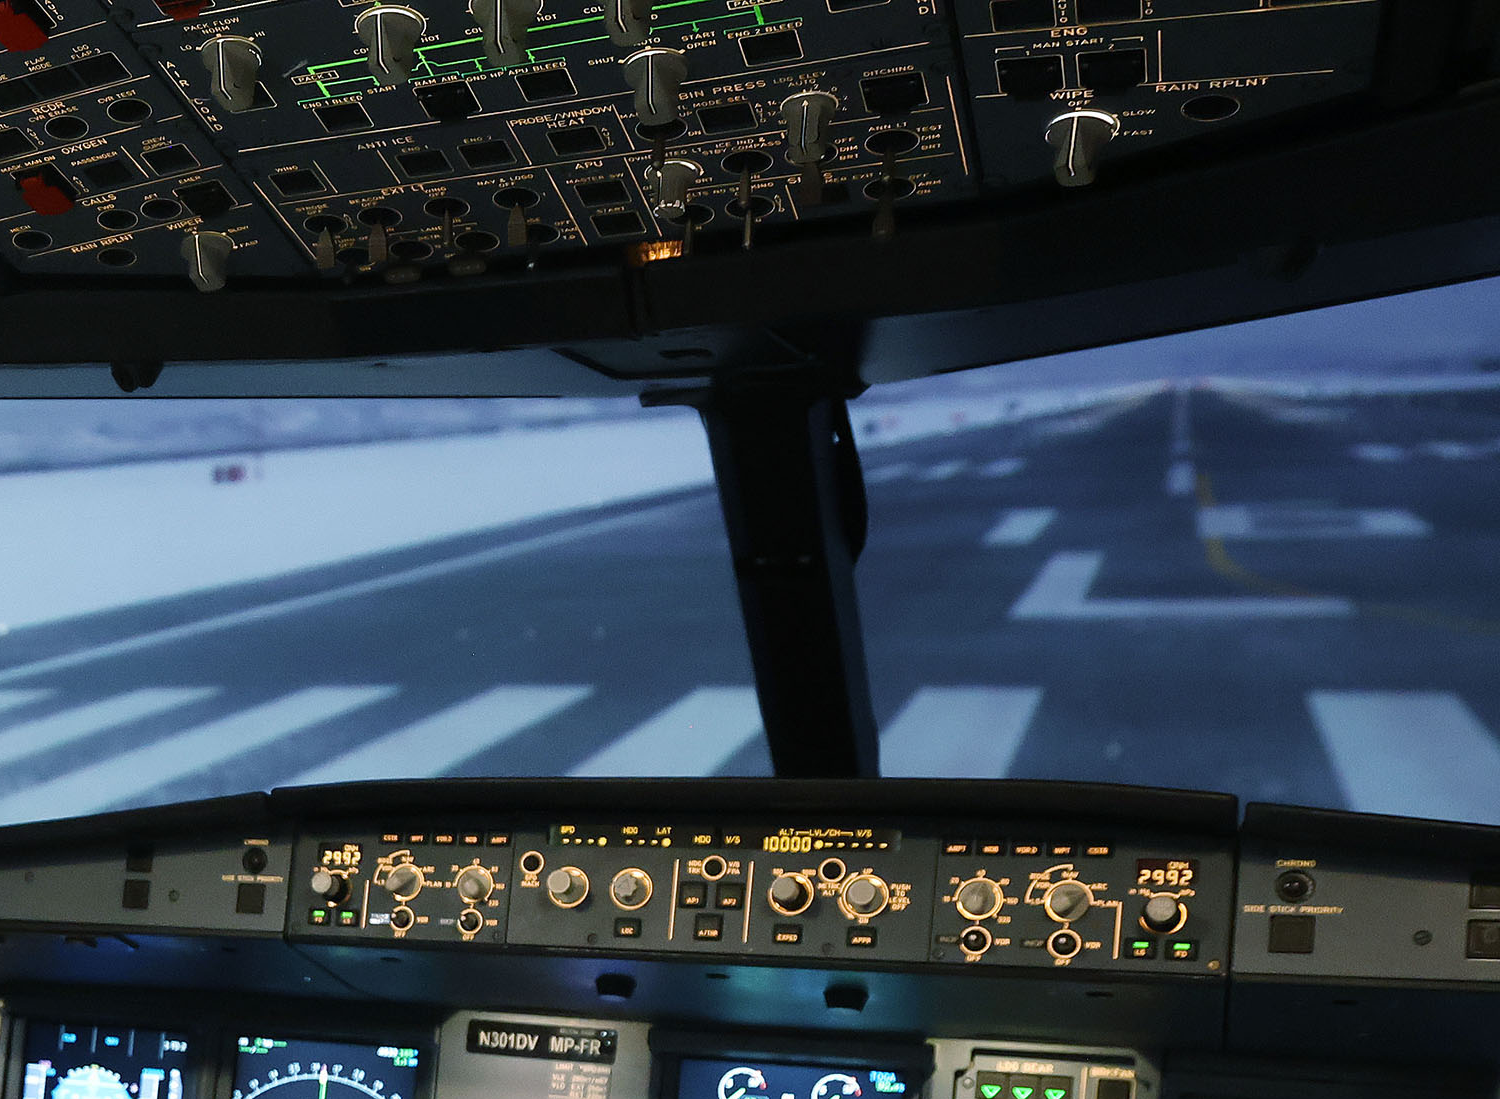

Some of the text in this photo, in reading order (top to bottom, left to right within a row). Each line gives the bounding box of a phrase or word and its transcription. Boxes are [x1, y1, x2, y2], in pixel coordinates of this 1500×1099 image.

[536, 14, 558, 23] HOT
[765, 21, 802, 33] BLEED
[1050, 27, 1088, 39] ENG
[420, 34, 441, 43] HOT
[681, 30, 716, 42] START
[1033, 36, 1105, 50] MAN START
[686, 39, 716, 50] OPEN
[532, 60, 568, 72] BLEED
[588, 56, 615, 66] SHUT
[862, 64, 915, 78] DITCHING
[414, 77, 438, 87] RAM
[712, 79, 767, 94] PRESS
[1155, 76, 1270, 94] RAIN RPLNT
[366, 85, 397, 95] START
[31, 101, 66, 116] RCDR
[509, 105, 615, 127] PROBE/WINDOW
[547, 117, 586, 129] HEAT
[61, 138, 108, 156] OXYGEN
[356, 136, 415, 151] ANTI ICE
[574, 160, 604, 171] APU
[81, 192, 117, 207] CALLS
[166, 217, 204, 232] WIPER
[70, 233, 134, 254] RAIN RPLNT
[763, 836, 812, 853] 10000
[322, 851, 361, 865] 2992
[1137, 870, 1193, 886] 2992
[479, 1030, 539, 1052] N301DV
[550, 1036, 601, 1055] MP-FR
